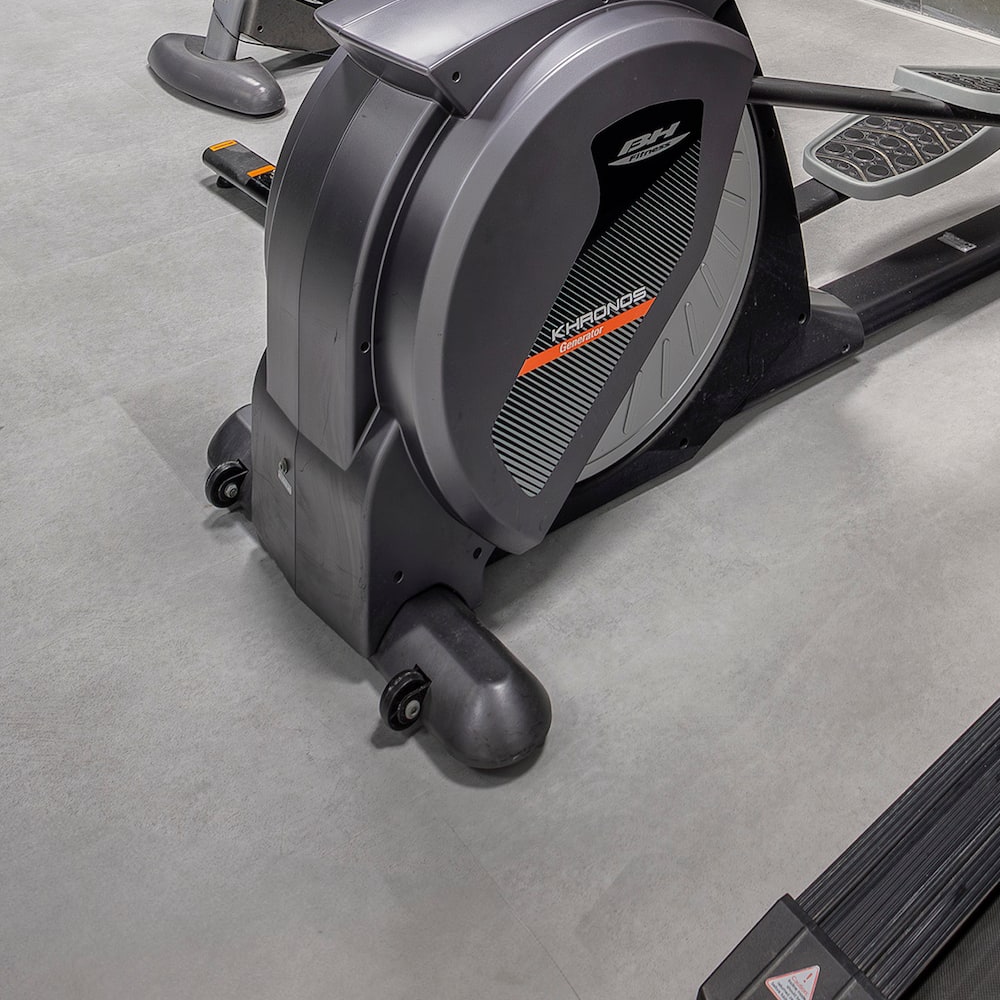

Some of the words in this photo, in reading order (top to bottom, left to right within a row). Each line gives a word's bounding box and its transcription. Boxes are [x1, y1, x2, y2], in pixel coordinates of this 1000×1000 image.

[617, 121, 681, 157] BH
[627, 140, 674, 163] Fitness
[551, 285, 647, 342] KHRONOS
[558, 324, 605, 355] Generator
